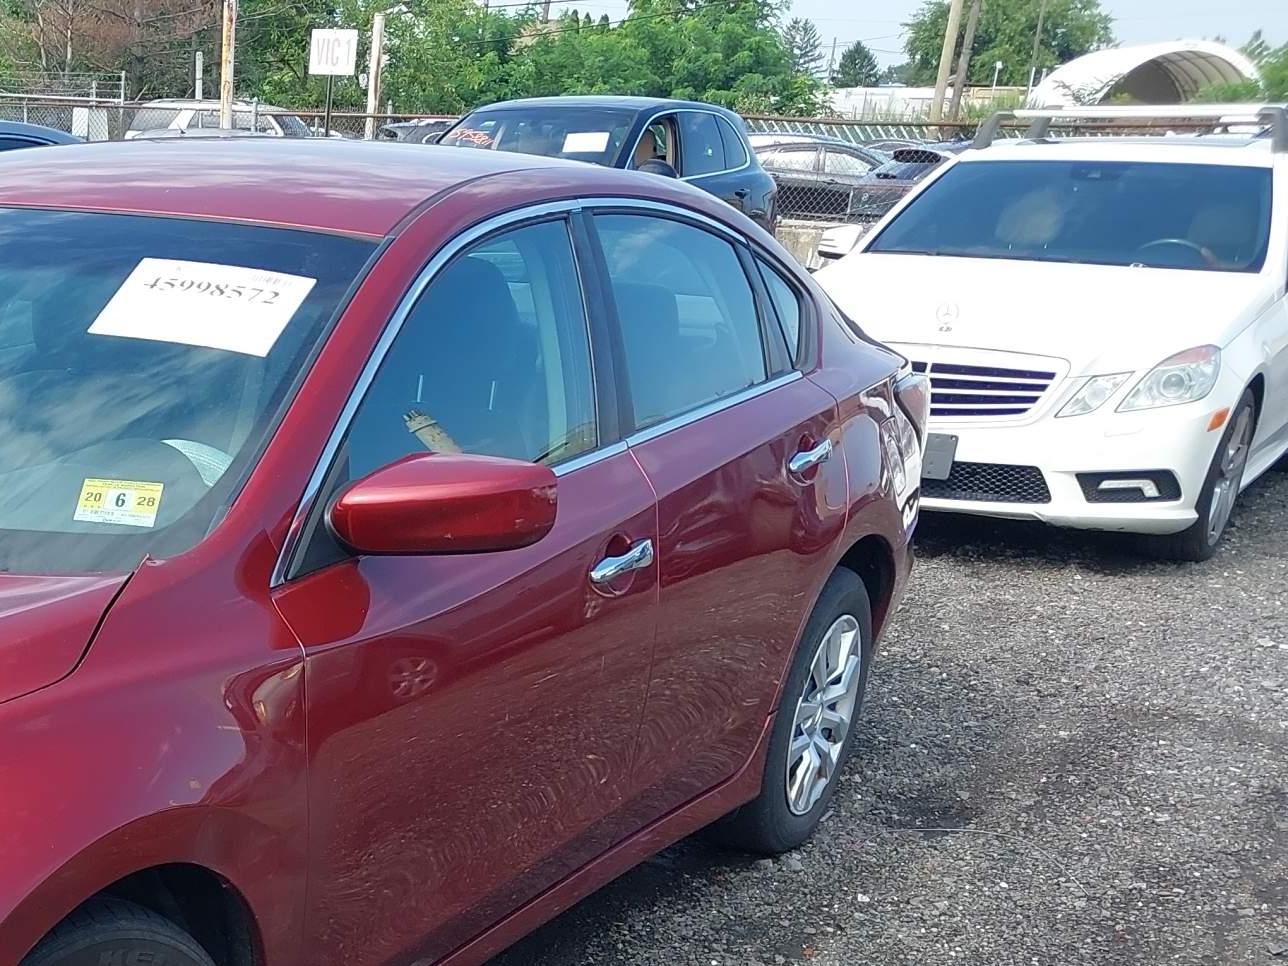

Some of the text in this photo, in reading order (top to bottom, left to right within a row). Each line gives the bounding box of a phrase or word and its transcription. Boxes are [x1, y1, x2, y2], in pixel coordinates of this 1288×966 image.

[316, 36, 352, 67] VIC 1
[143, 276, 281, 305] 45998572
[85, 491, 156, 508] 20 6 28
